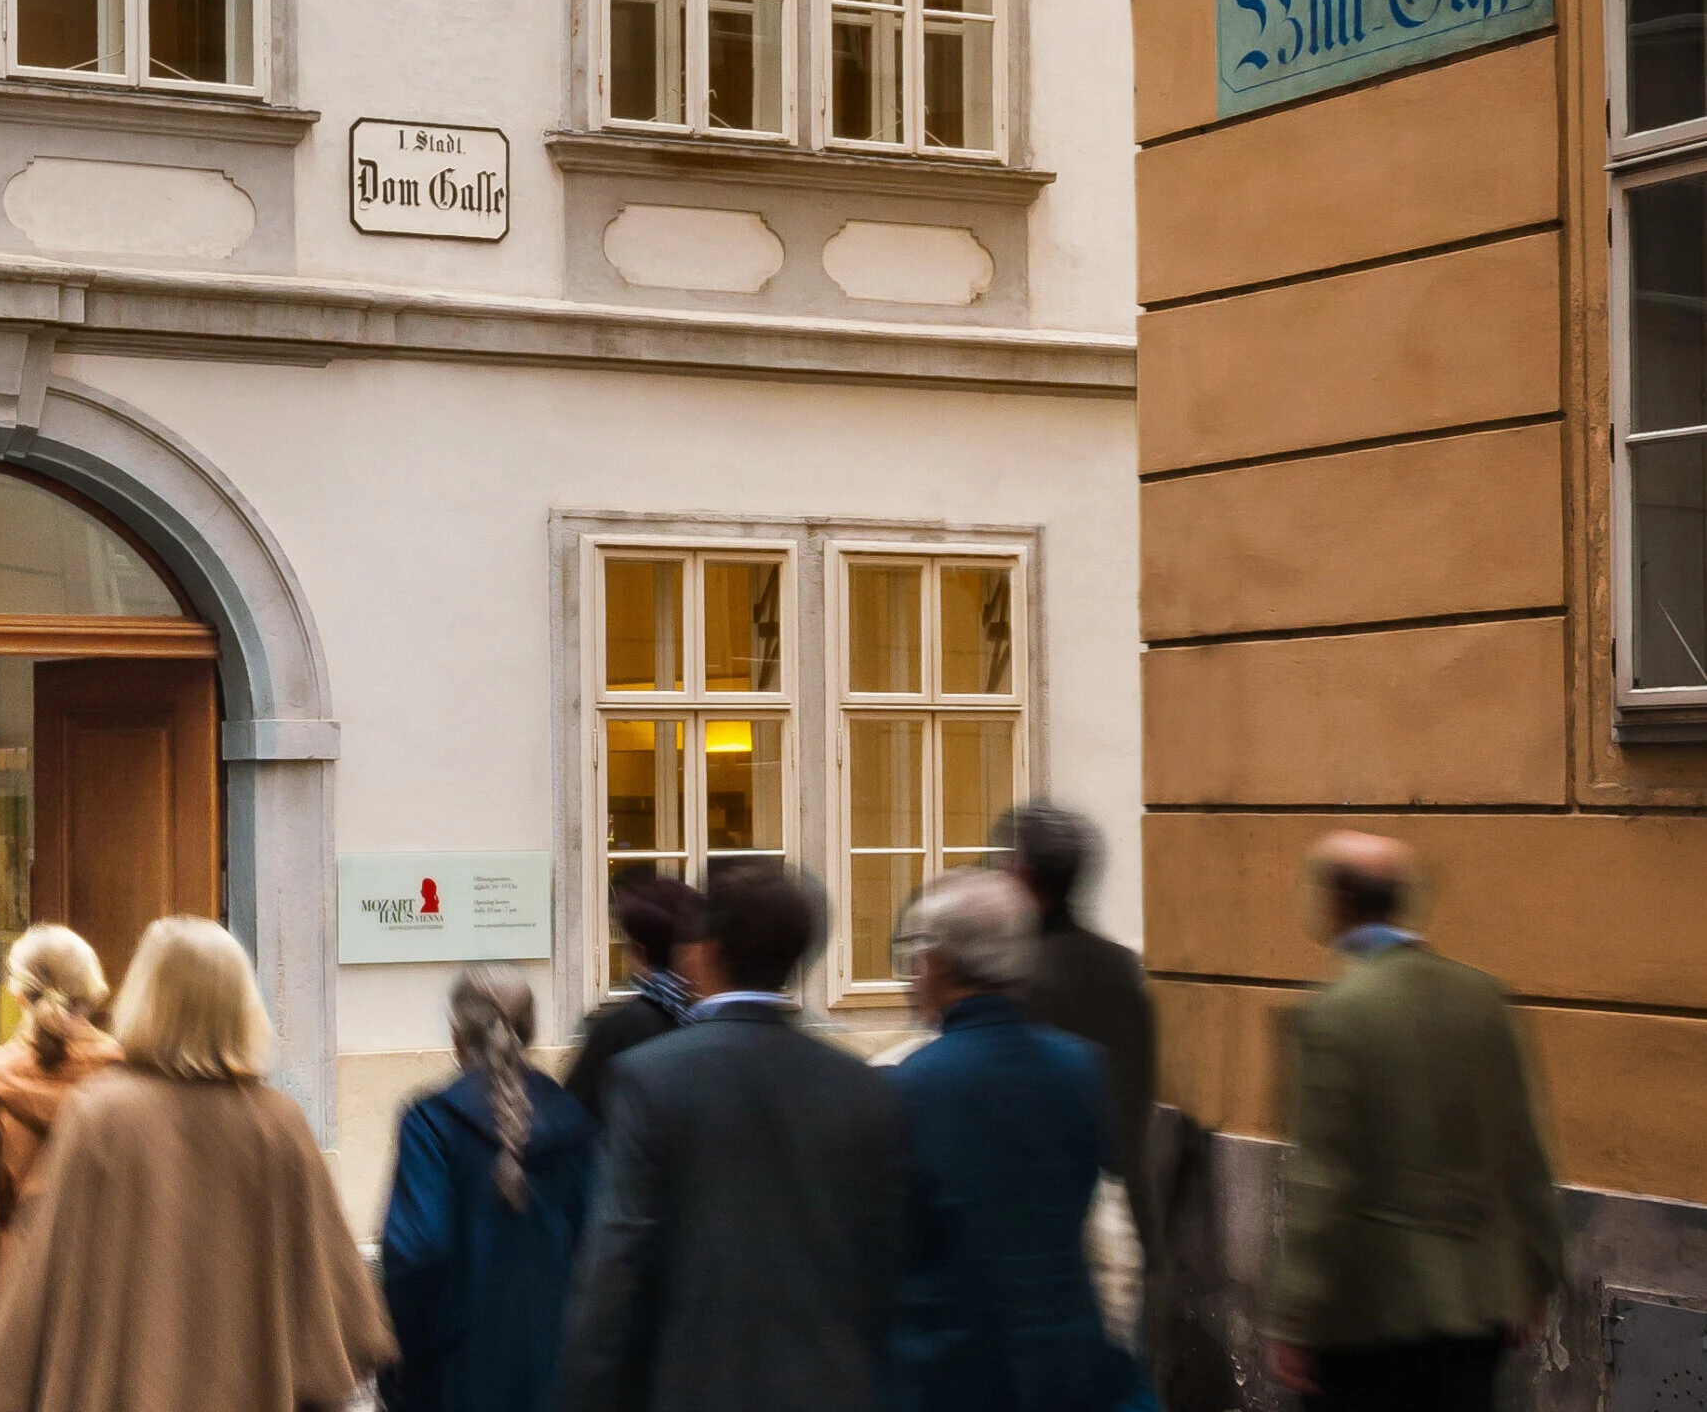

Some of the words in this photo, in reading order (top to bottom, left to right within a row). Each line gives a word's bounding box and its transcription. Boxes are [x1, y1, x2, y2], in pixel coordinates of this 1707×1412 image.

[357, 157, 420, 210] Dom
[361, 899, 415, 913] MOZART
[379, 911, 414, 924] HAUS
[415, 915, 444, 923] VIENNA
